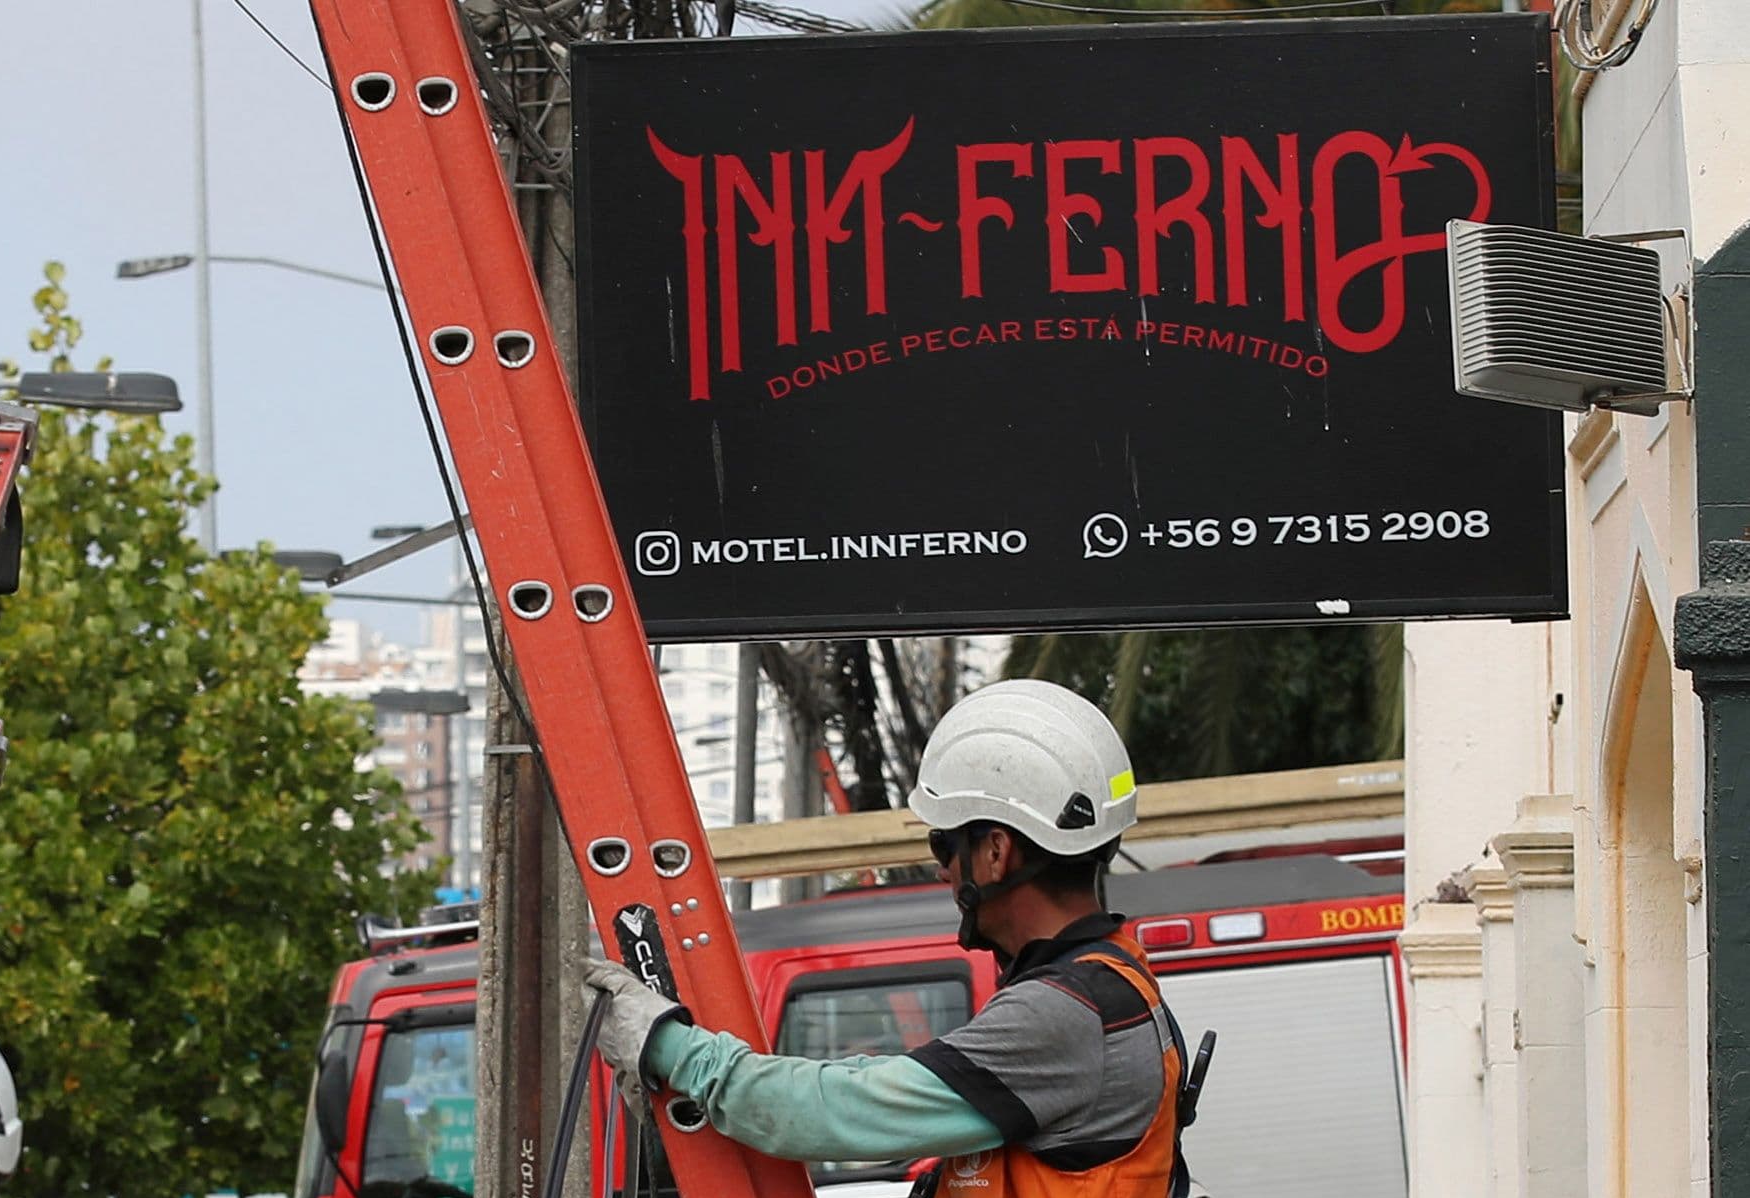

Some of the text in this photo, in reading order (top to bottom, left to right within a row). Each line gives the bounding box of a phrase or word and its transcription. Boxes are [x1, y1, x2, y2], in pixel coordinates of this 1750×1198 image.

[766, 313, 1329, 399] DONDE PECAR ESTÁ PERMITIDO
[691, 529, 1028, 565] MOTEL.INNFERNO
[1140, 510, 1491, 548] +56 9 7315 2908
